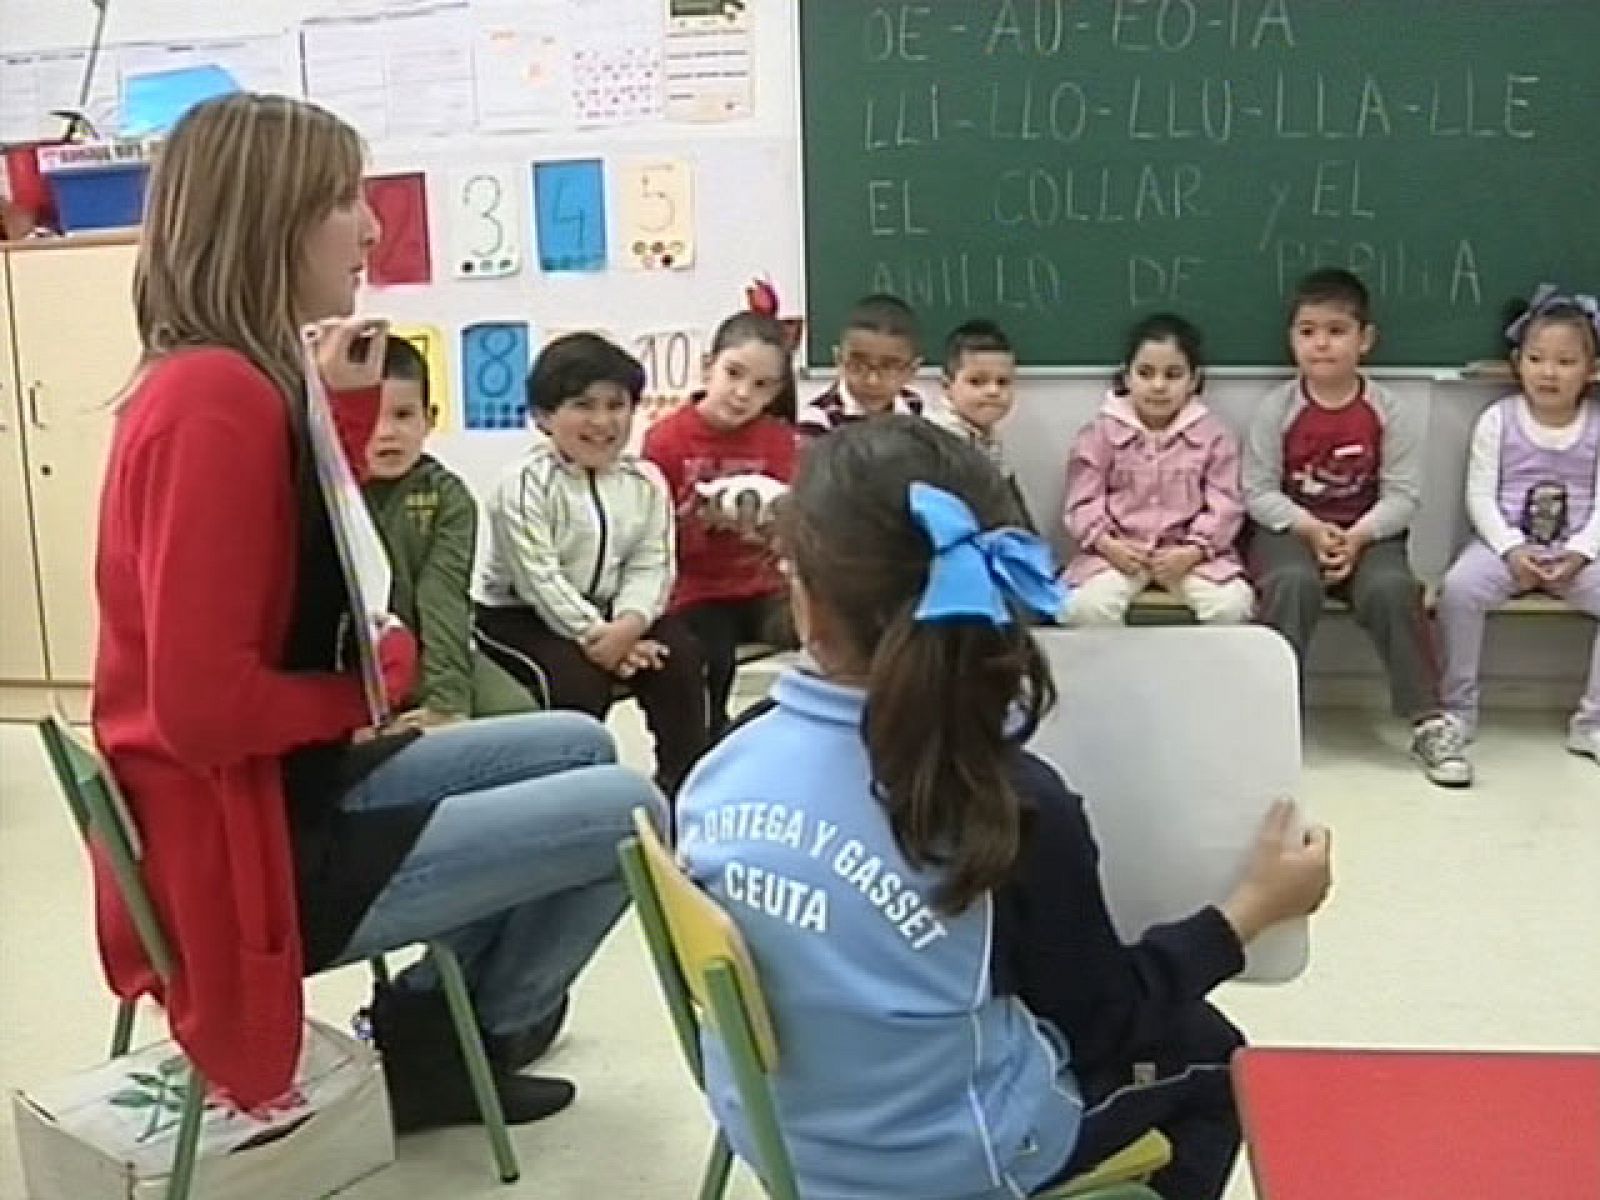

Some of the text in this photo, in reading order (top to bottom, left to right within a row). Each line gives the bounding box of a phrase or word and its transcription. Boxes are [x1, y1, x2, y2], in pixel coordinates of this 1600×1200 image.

[463, 174, 504, 257] 3
[553, 175, 586, 249] 4
[636, 163, 676, 233] 5
[868, 179, 929, 236] EL
[993, 163, 1204, 227] COLLAR
[1312, 159, 1376, 219] EL
[1128, 255, 1206, 307] DE
[477, 327, 517, 398] 8
[635, 331, 690, 391] 10
[703, 802, 807, 848] ORTEGA
[809, 820, 839, 858] Y
[832, 839, 949, 950] GASSET
[724, 861, 830, 932] CEUTA
